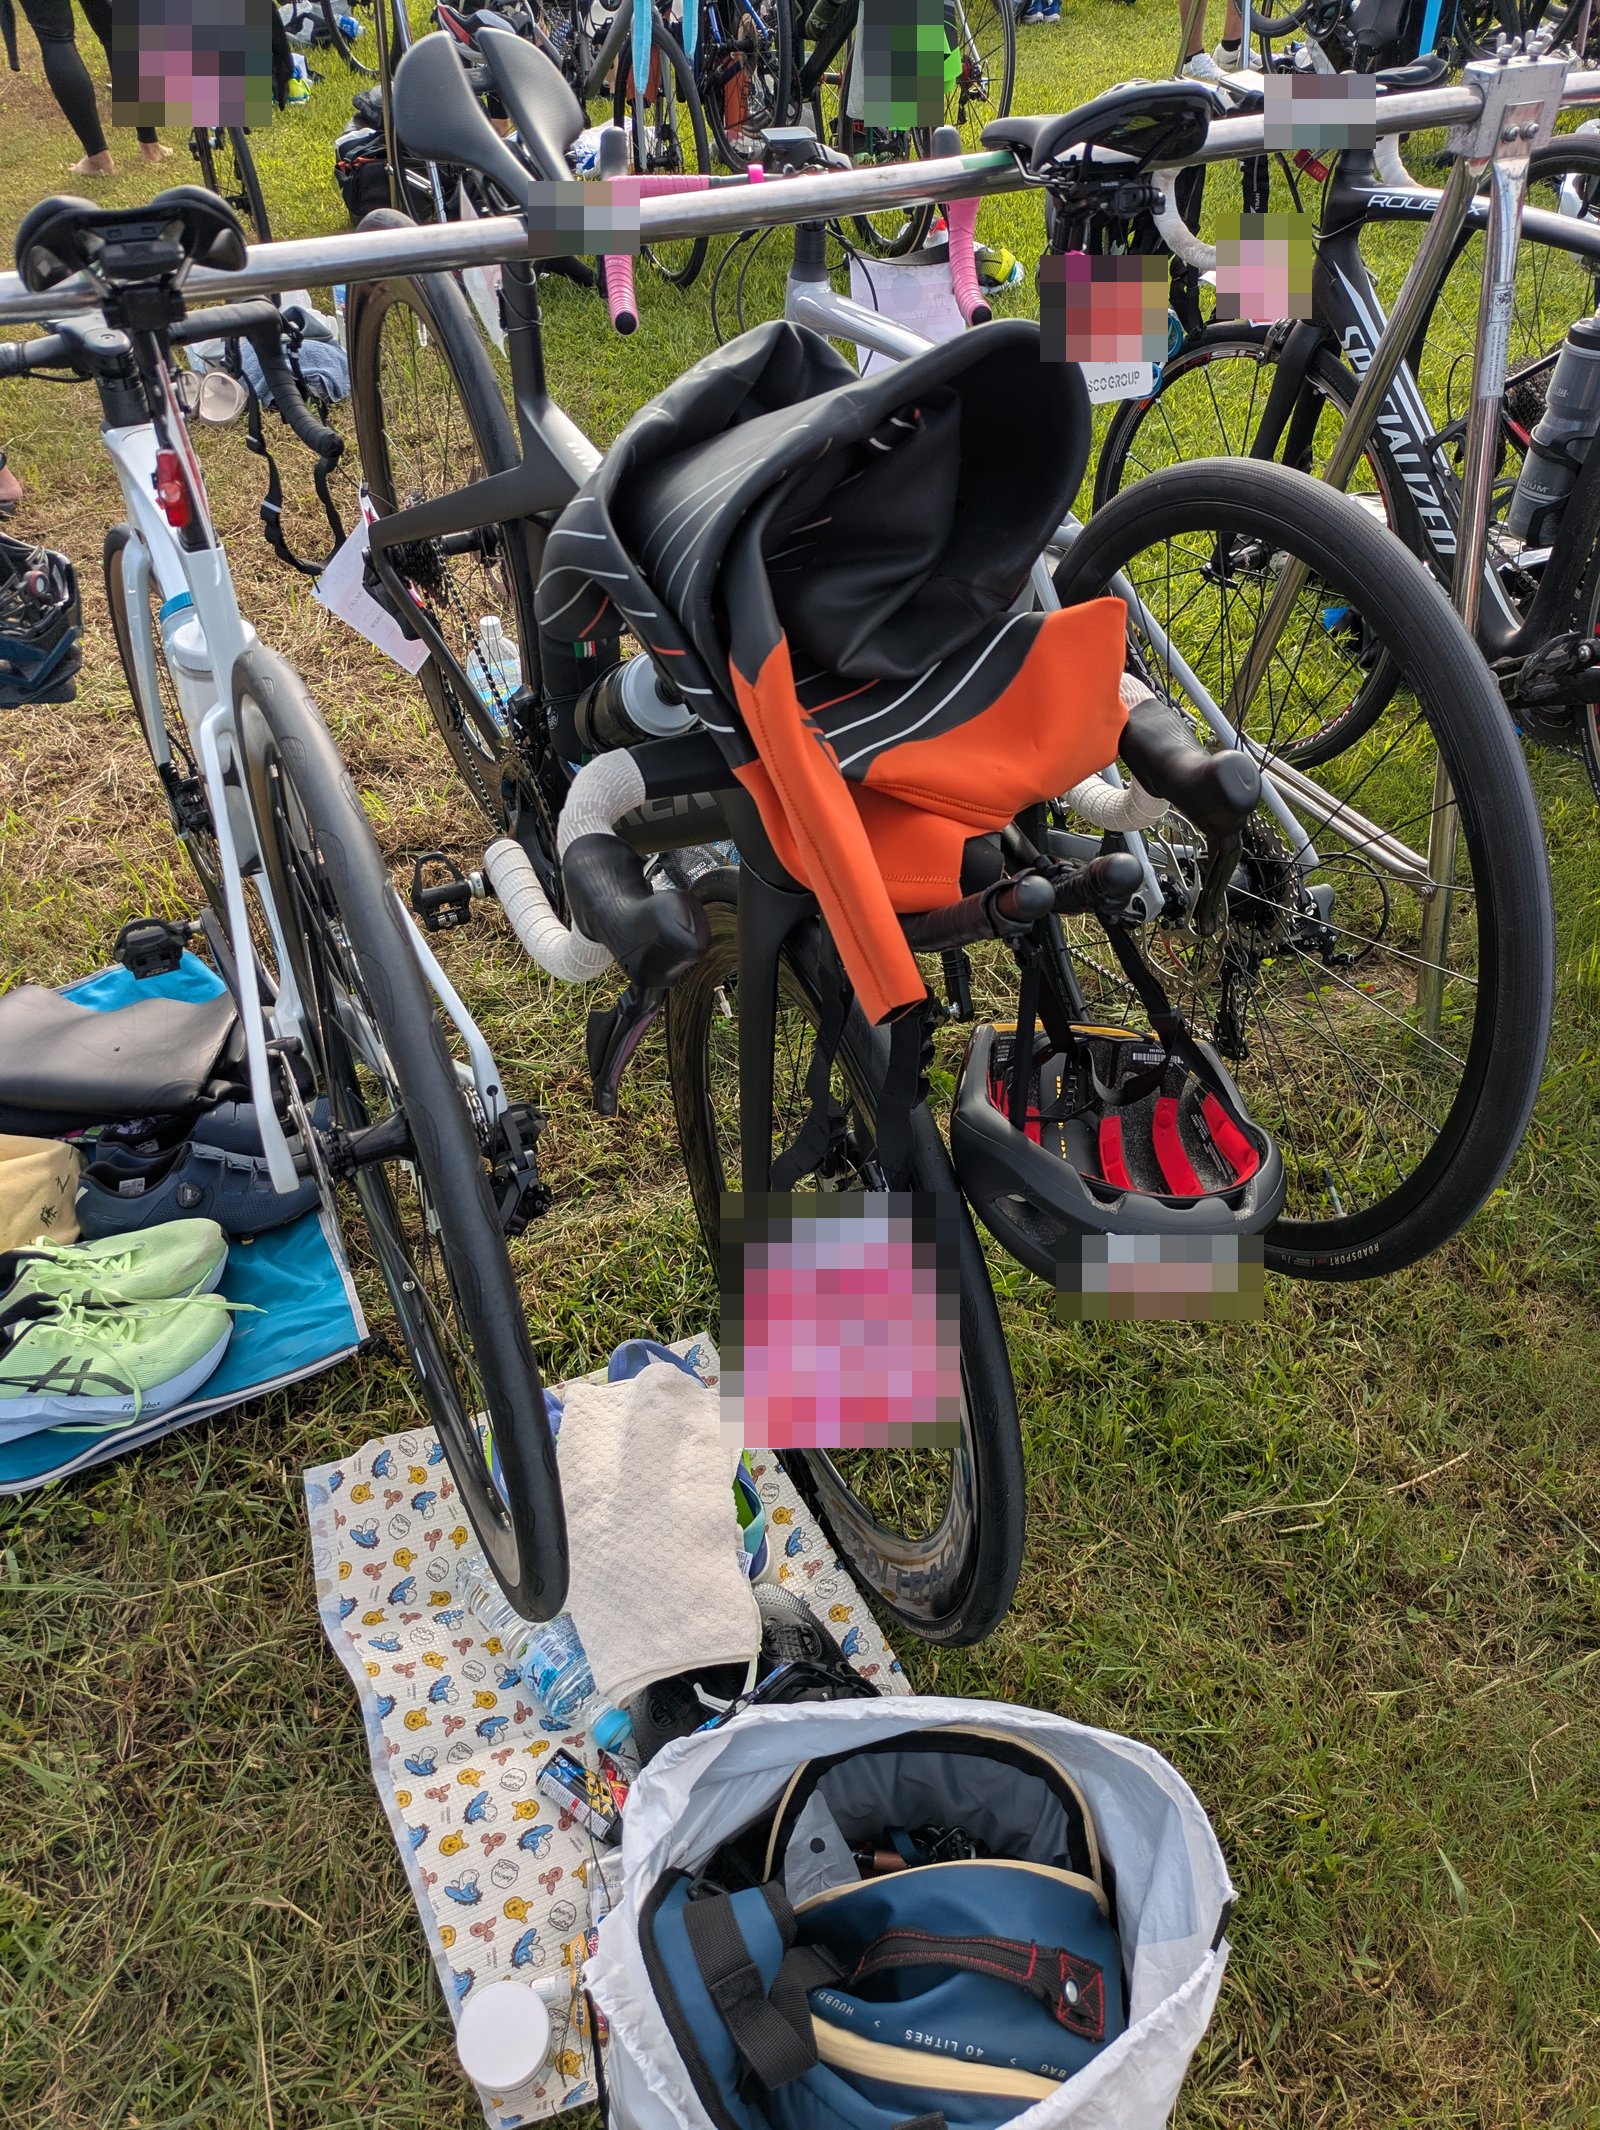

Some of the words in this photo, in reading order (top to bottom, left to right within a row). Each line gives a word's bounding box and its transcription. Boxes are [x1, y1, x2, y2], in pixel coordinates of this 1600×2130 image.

[1367, 194, 1489, 216] ROUBX
[1341, 325, 1457, 554] SPIALIZED
[1329, 1242, 1380, 1266] ROADSPORT
[905, 2029, 958, 2052] LITRES
[965, 2046, 984, 2057] 40
[1040, 2063, 1066, 2078] BAG
